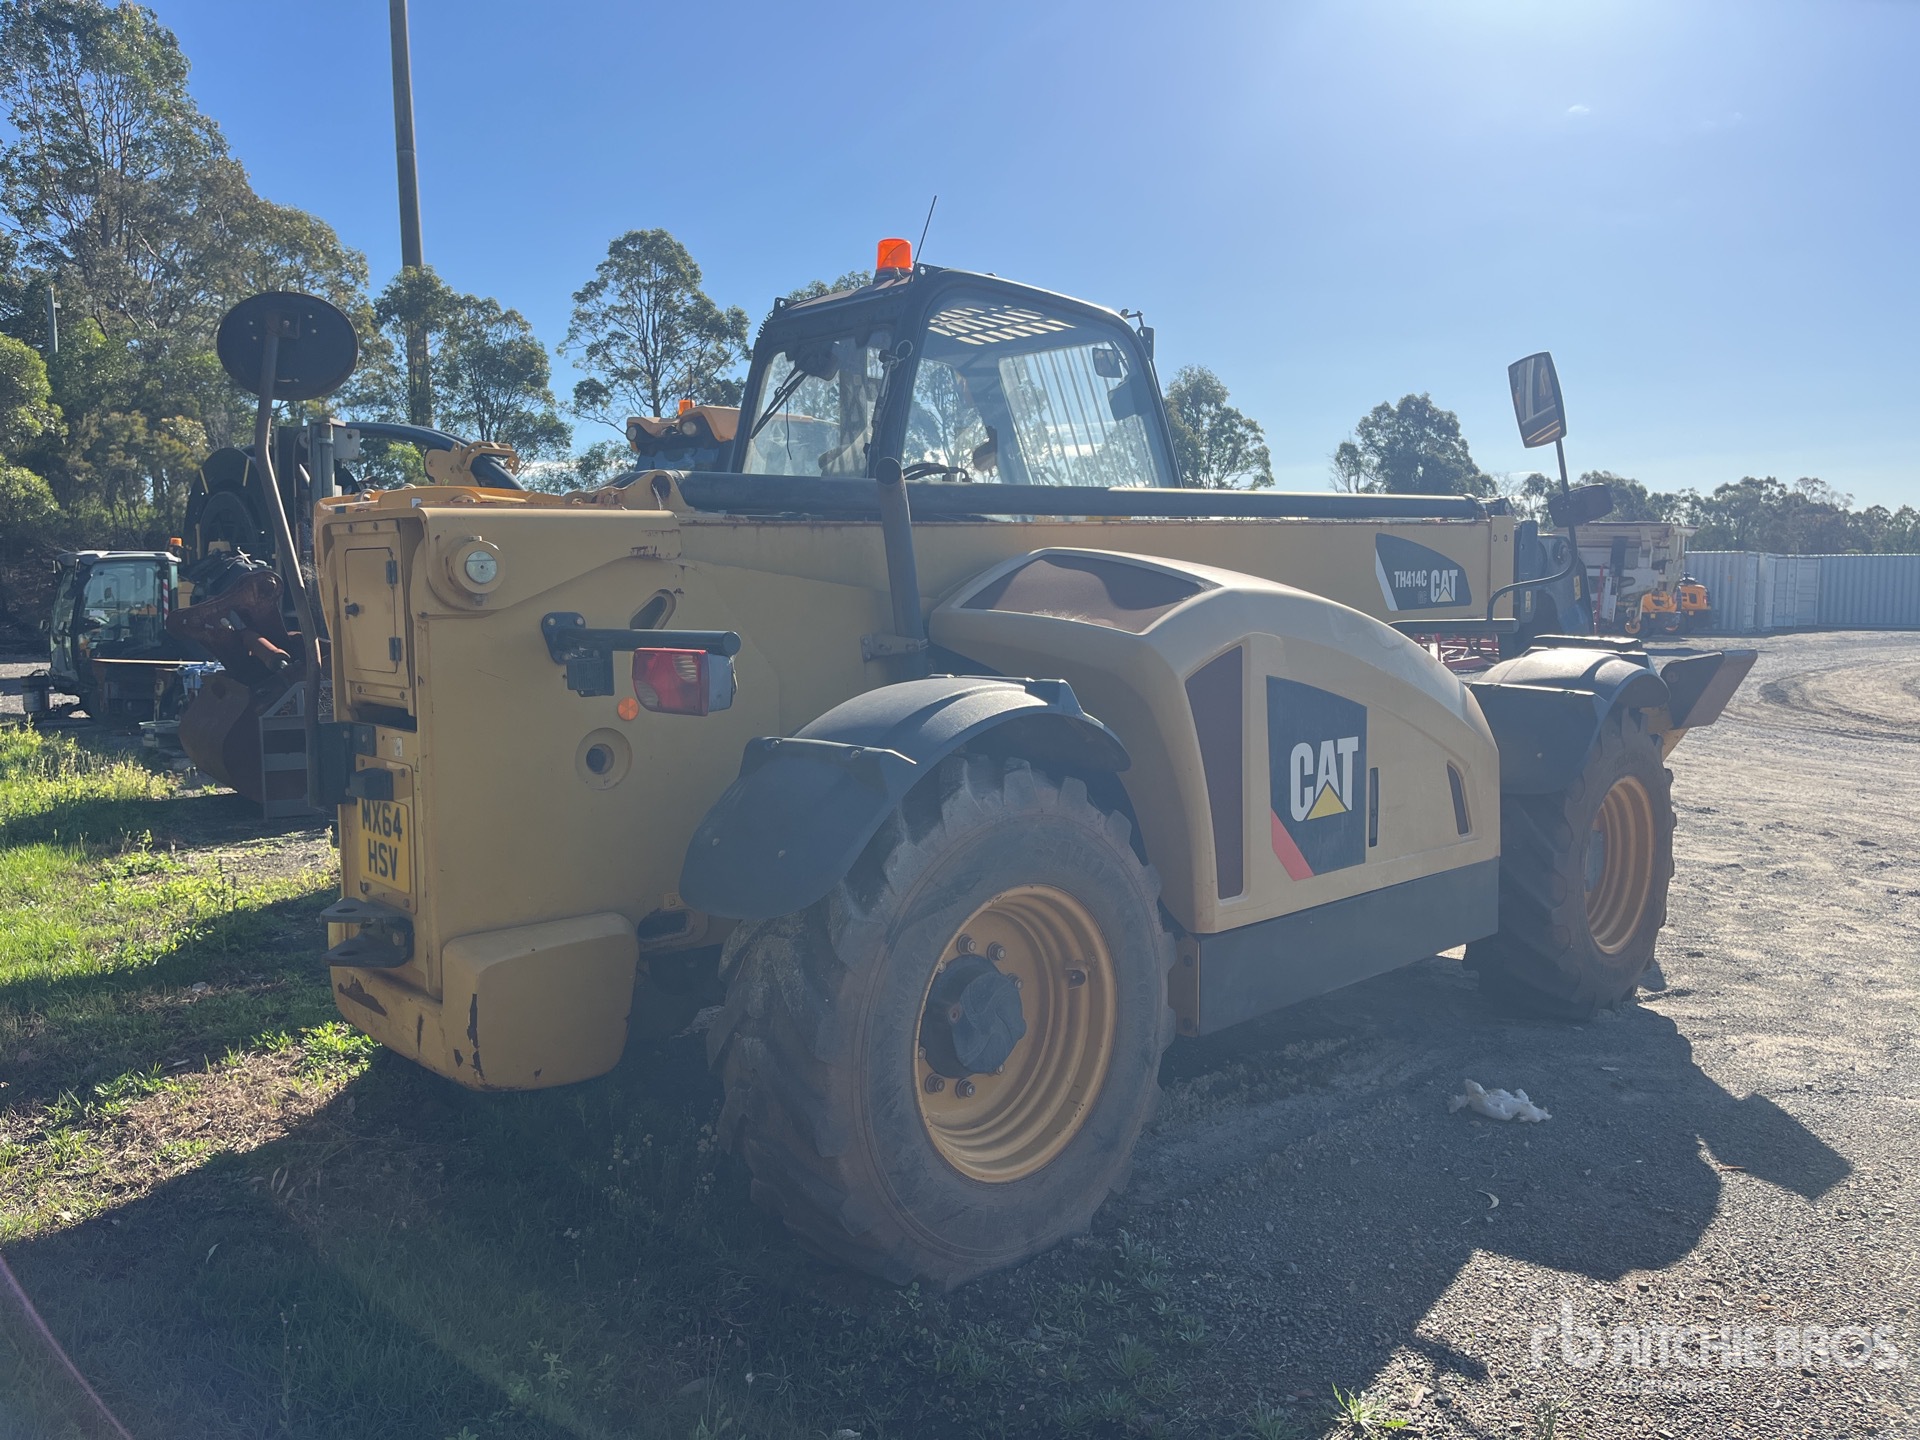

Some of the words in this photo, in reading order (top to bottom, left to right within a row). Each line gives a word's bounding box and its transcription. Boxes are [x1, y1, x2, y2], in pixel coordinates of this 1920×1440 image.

[1394, 570, 1428, 588] TH414C
[1430, 569, 1458, 603] CAT
[1290, 736, 1359, 822] CAT
[361, 799, 403, 842] MX64
[367, 838, 398, 881] HSV
